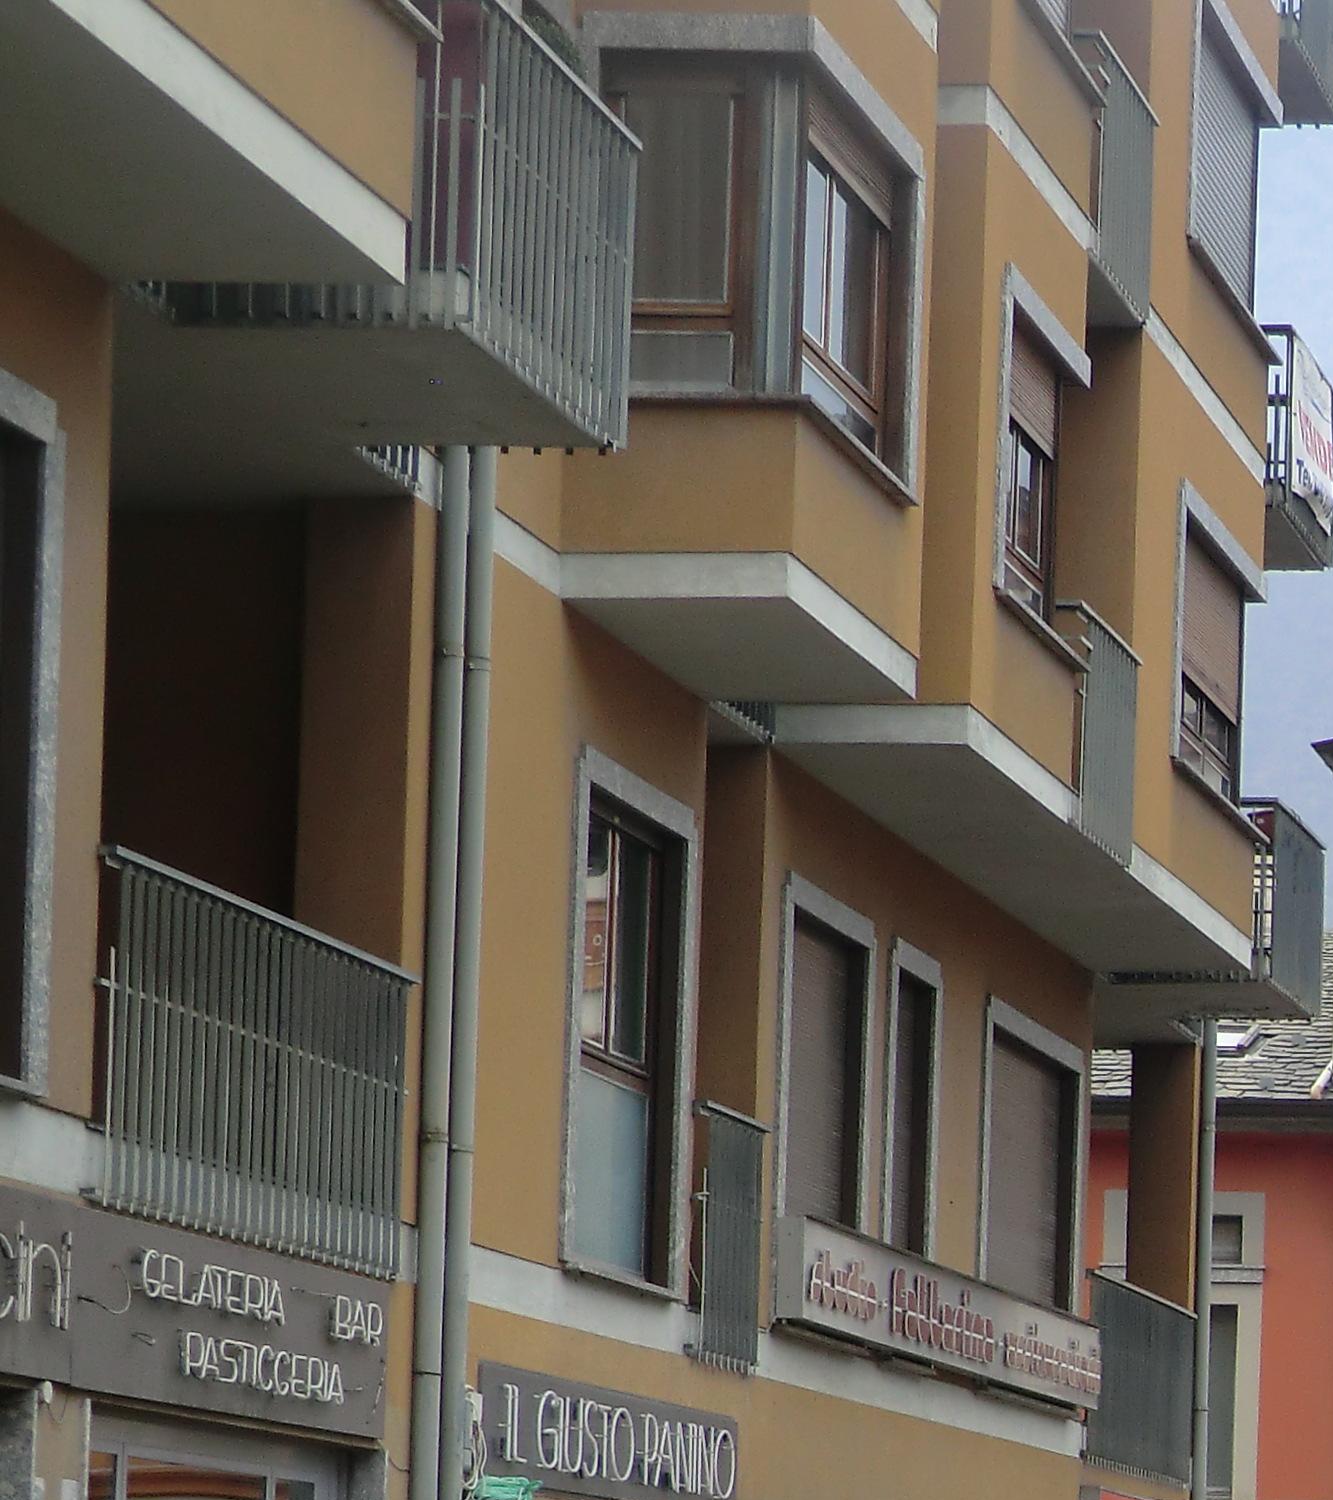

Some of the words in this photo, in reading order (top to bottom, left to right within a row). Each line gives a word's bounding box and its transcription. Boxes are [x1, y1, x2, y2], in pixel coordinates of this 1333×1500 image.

[141, 1248, 286, 1327] GELATERIA
[332, 1295, 383, 1346] BAR
[180, 1330, 345, 1405] PASTICCERIA
[502, 1383, 528, 1464] IL
[536, 1390, 635, 1482] GIUSTO
[643, 1412, 736, 1499] PANINO
